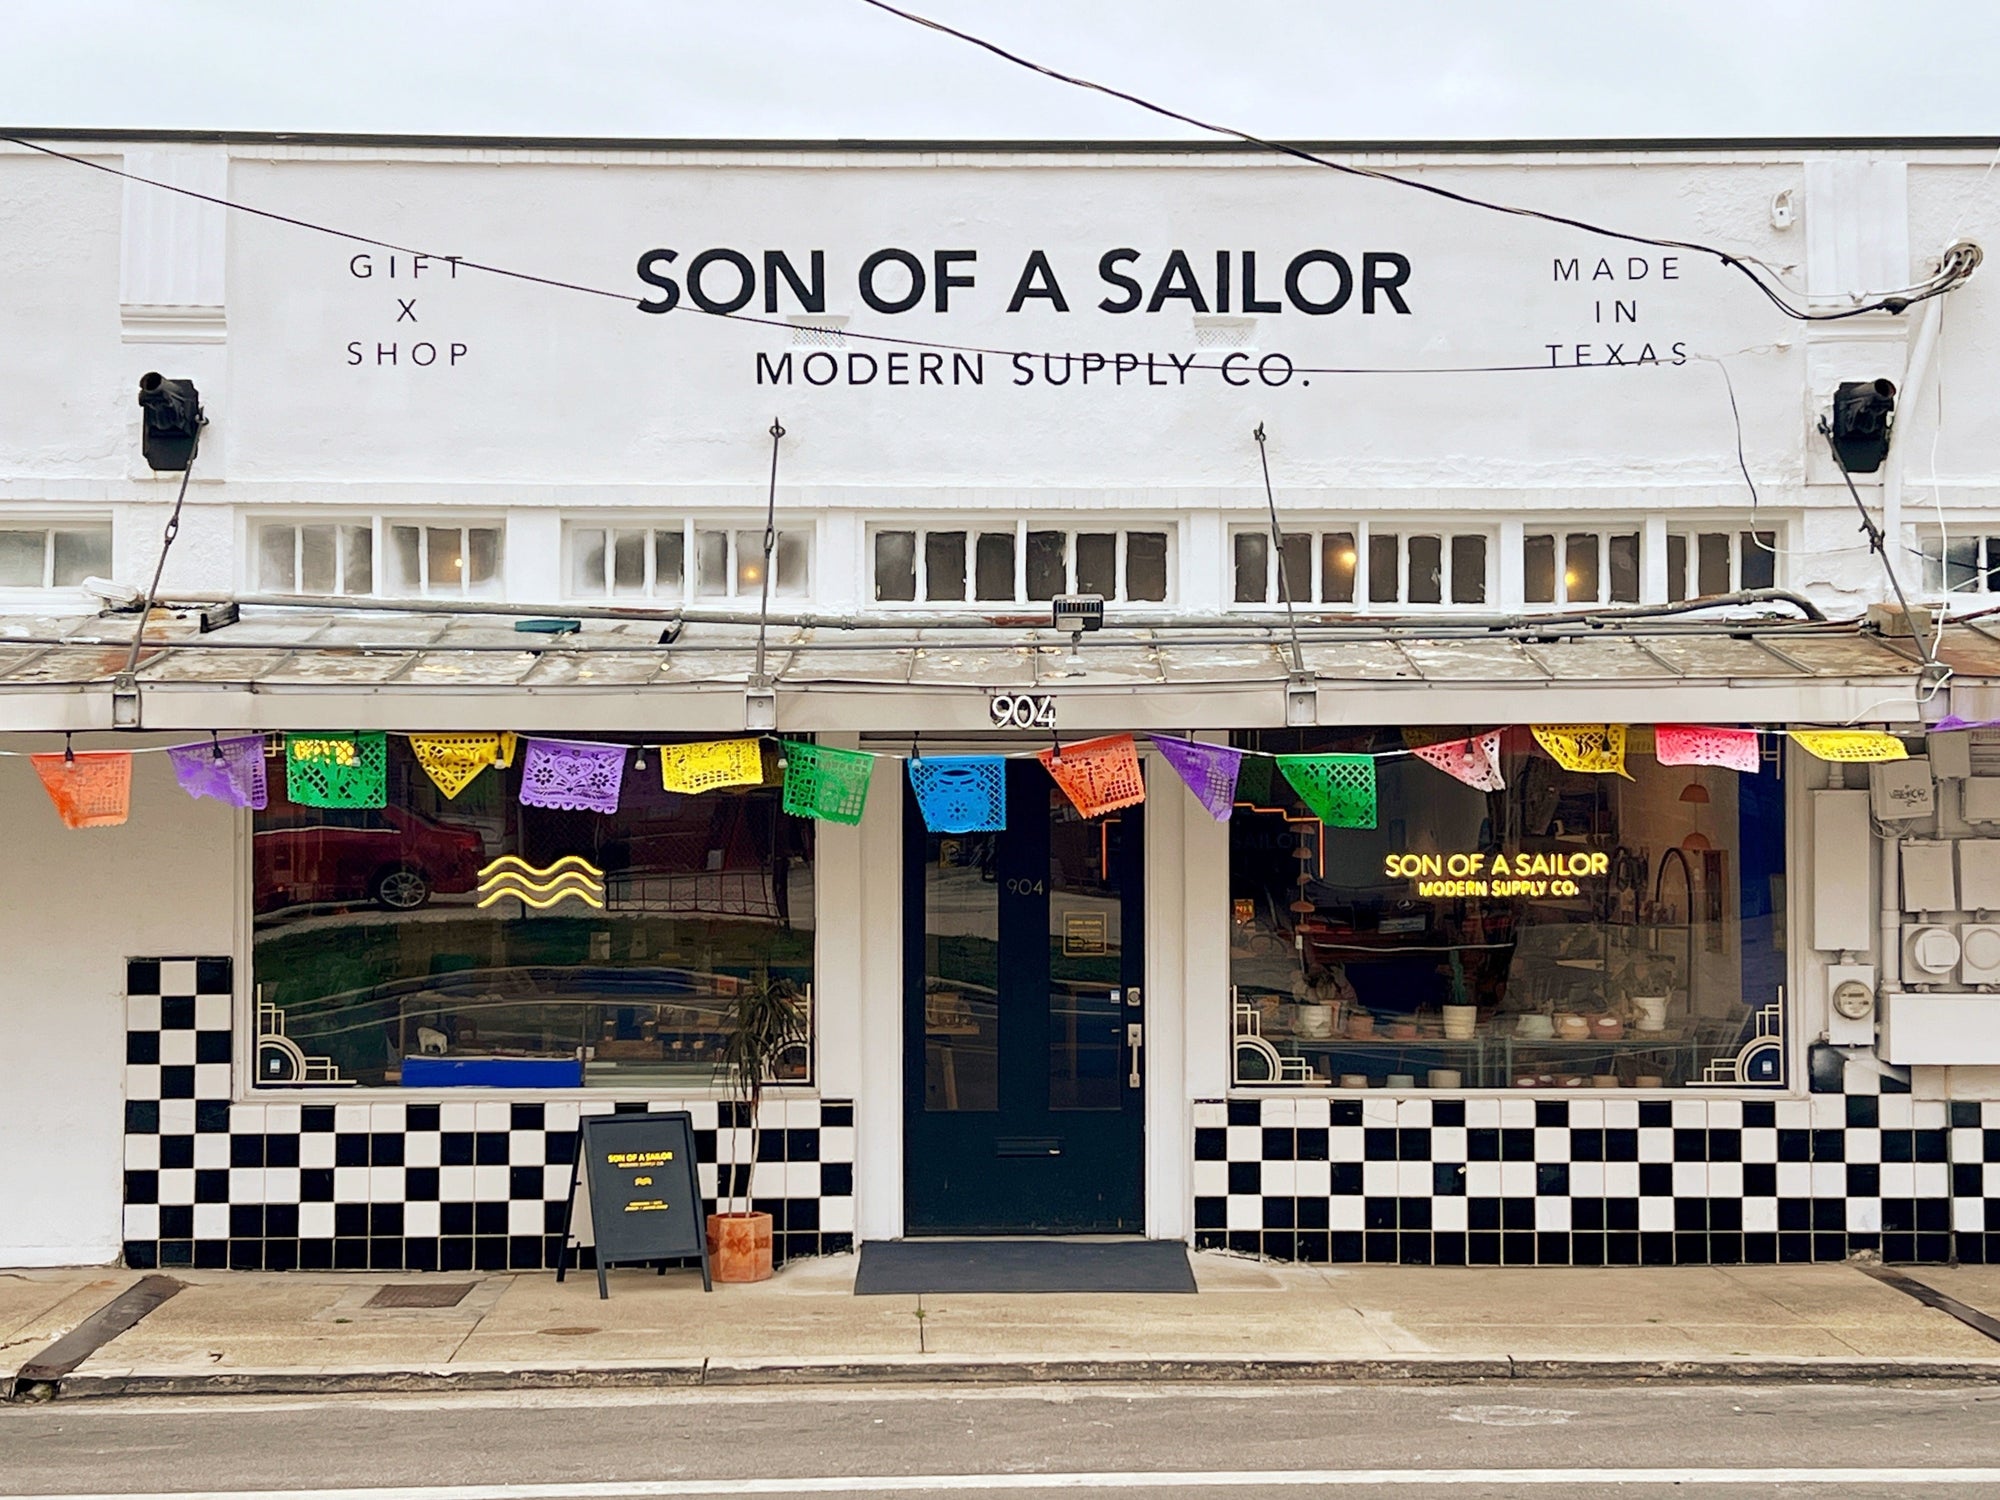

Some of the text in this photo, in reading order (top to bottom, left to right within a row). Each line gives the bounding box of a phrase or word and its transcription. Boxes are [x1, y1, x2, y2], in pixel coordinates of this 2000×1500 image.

[350, 254, 463, 279] GIFT
[1554, 257, 1679, 281] MADE
[635, 247, 1412, 315] SON OF A SAILOR
[397, 298, 418, 322] X
[1595, 300, 1636, 323] IN
[347, 341, 467, 366] SHOP
[1545, 341, 1687, 367] TEXAS
[756, 352, 1311, 387] MODERN SUPPLY CO.
[991, 695, 1057, 729] 904
[1385, 852, 1609, 878] SON OF A SAILOR
[1006, 877, 1044, 896] 904
[1418, 879, 1580, 898] MODERN SUPPLY CO.
[607, 1154, 626, 1164] SON
[626, 1152, 638, 1163] OF
[638, 1152, 646, 1162] A
